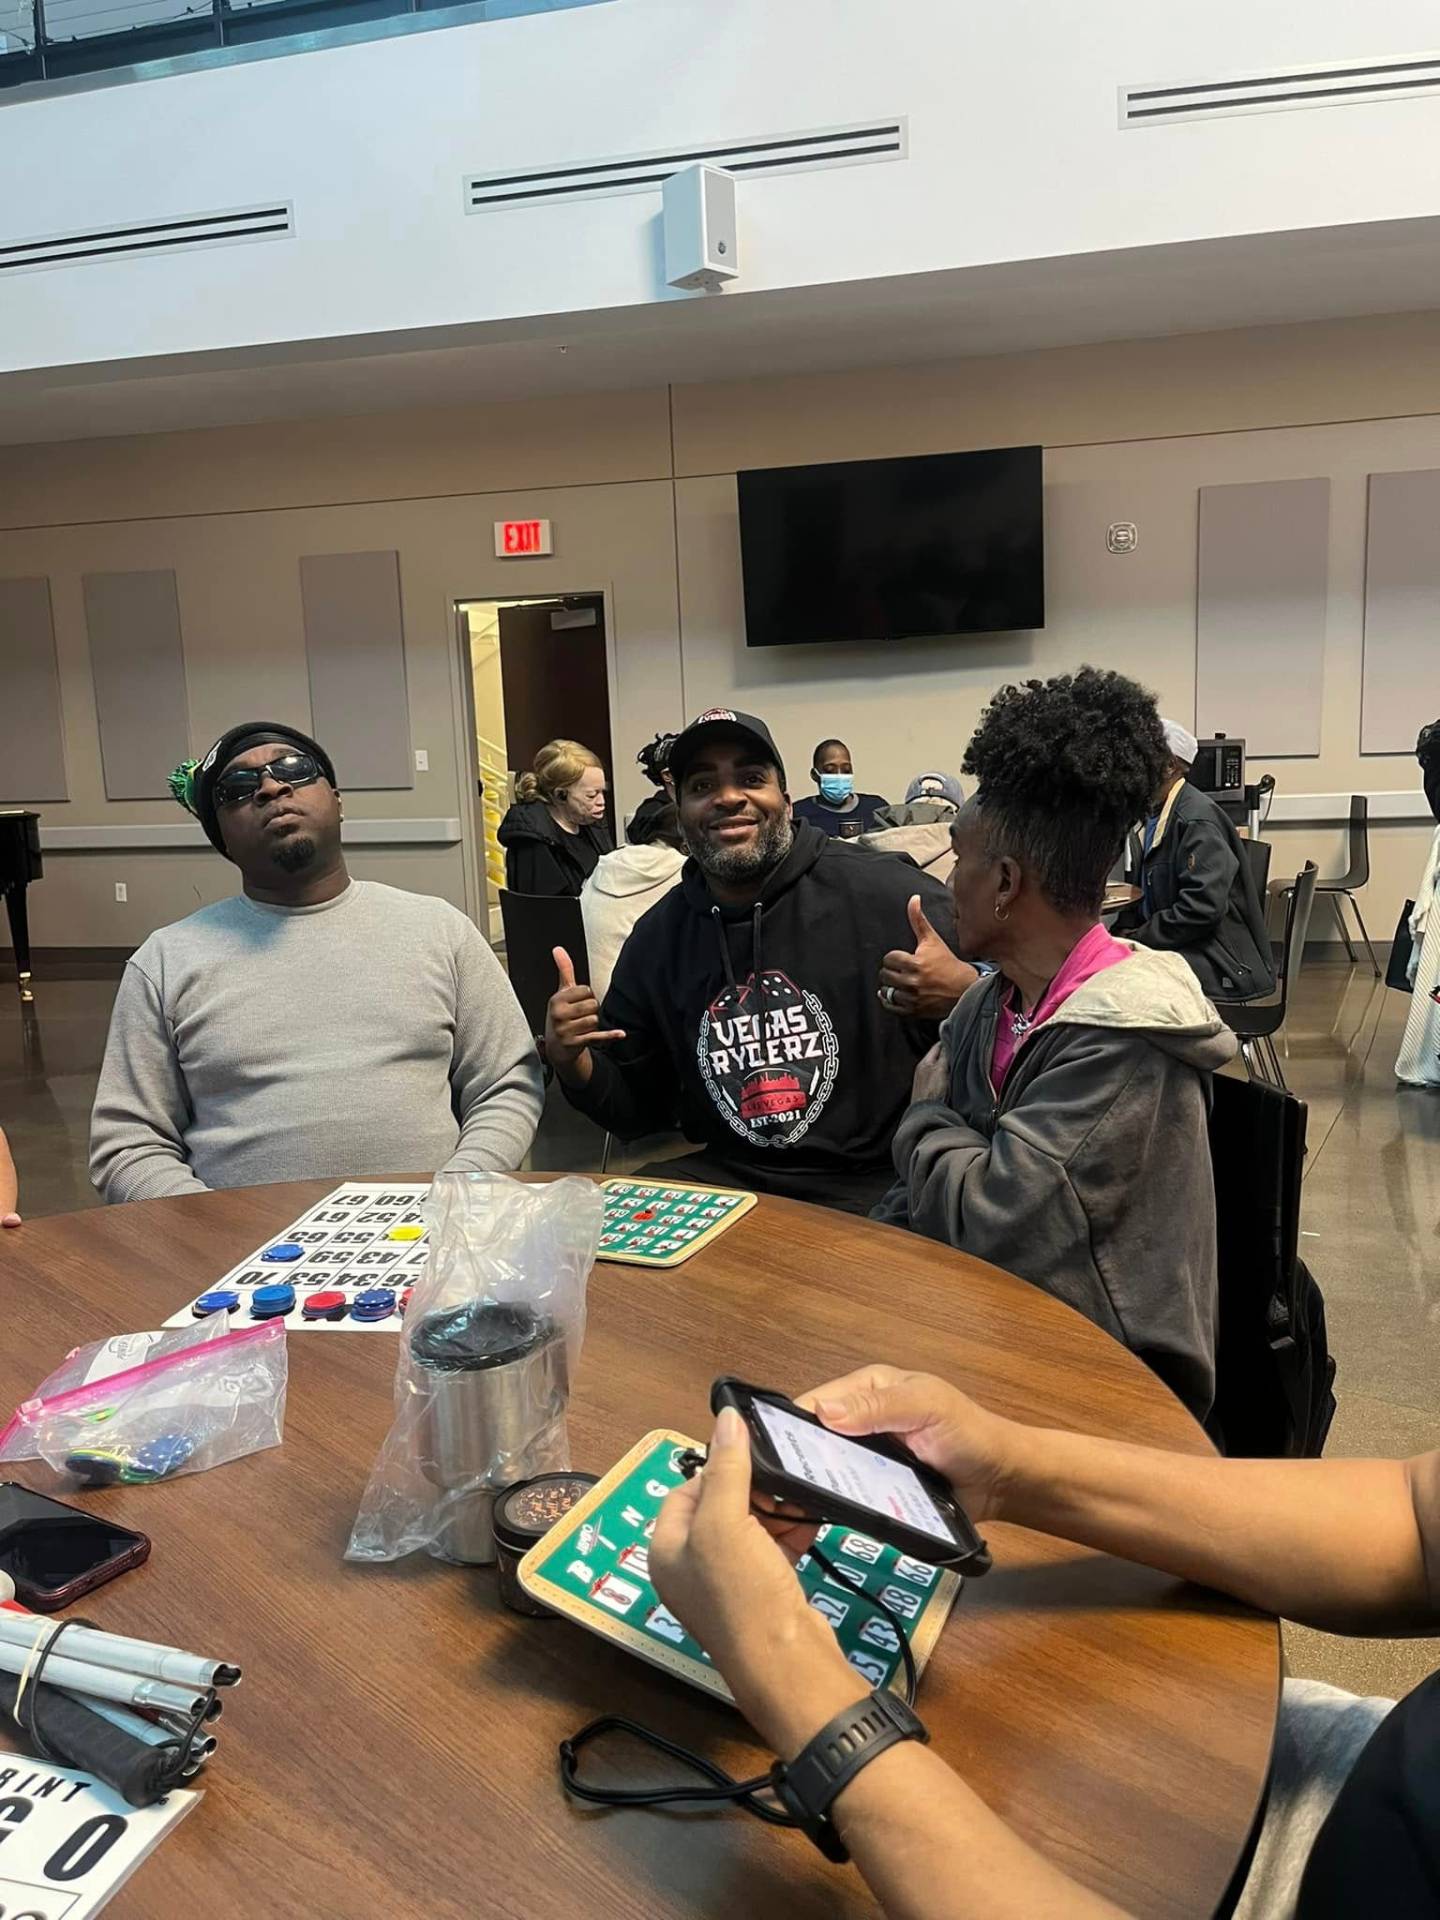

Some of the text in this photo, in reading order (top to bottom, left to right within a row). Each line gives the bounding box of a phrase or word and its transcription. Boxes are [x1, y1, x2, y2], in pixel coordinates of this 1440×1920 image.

[504, 521, 541, 553] EXIT
[709, 1031, 823, 1076] RYDERZ
[331, 1195, 415, 1206] 60 67
[312, 1211, 350, 1223] 61
[356, 1211, 397, 1223] 52
[284, 1231, 375, 1244] 55 65
[308, 1251, 354, 1264] 59
[356, 1251, 400, 1265] 43
[235, 1271, 278, 1286] 70
[288, 1272, 331, 1286] 53
[332, 1272, 379, 1287] 34
[845, 1538, 880, 1562] 68
[898, 1559, 932, 1585] 66
[880, 1588, 918, 1616] 48
[43, 1814, 128, 1882] O
